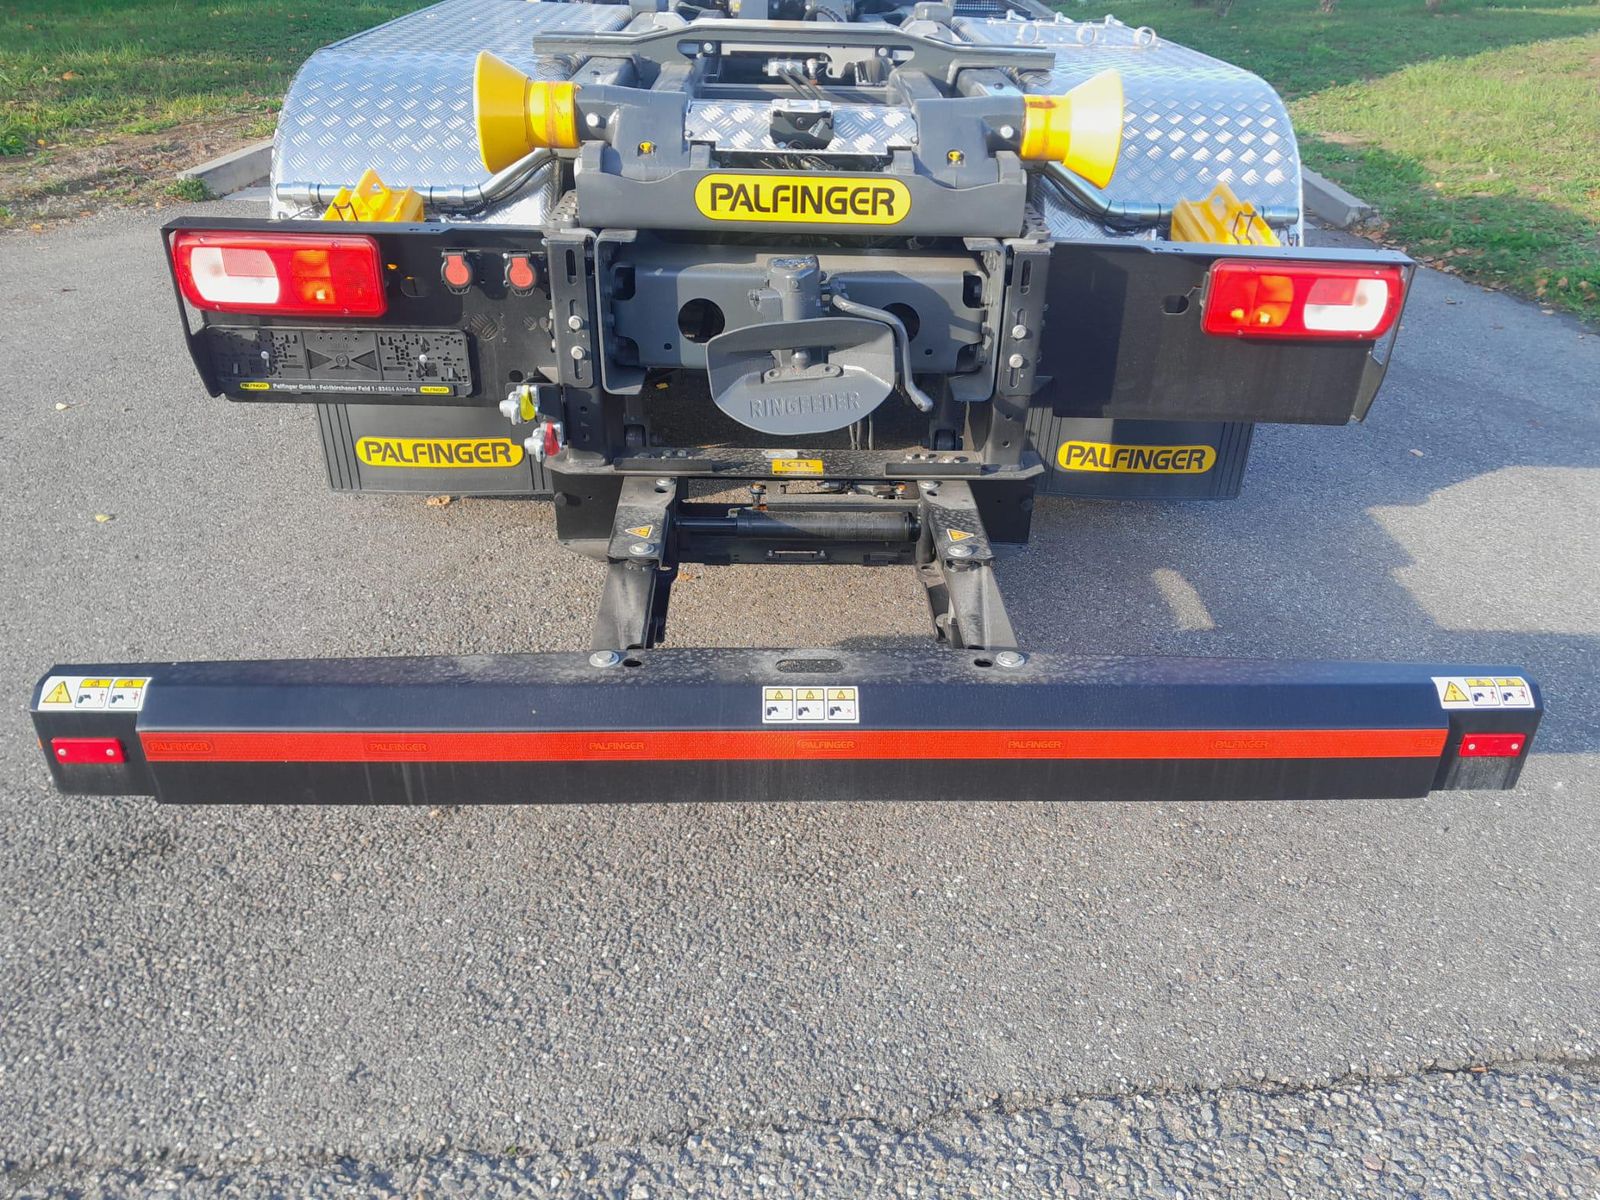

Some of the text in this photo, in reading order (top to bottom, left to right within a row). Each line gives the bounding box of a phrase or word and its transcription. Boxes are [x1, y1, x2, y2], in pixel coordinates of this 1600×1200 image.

[711, 182, 895, 216] PALFINGER
[749, 392, 861, 418] RINGFEDER
[364, 441, 512, 463] PALFINGER
[1065, 445, 1206, 469] PALFINGER
[151, 742, 209, 751] PALFINGER
[369, 743, 427, 751] PALFINGER
[589, 742, 645, 750] PALFINGER
[800, 741, 855, 749] PALFINGER
[1007, 740, 1063, 749] PALFINGER
[1214, 740, 1269, 749] PALFINGER
